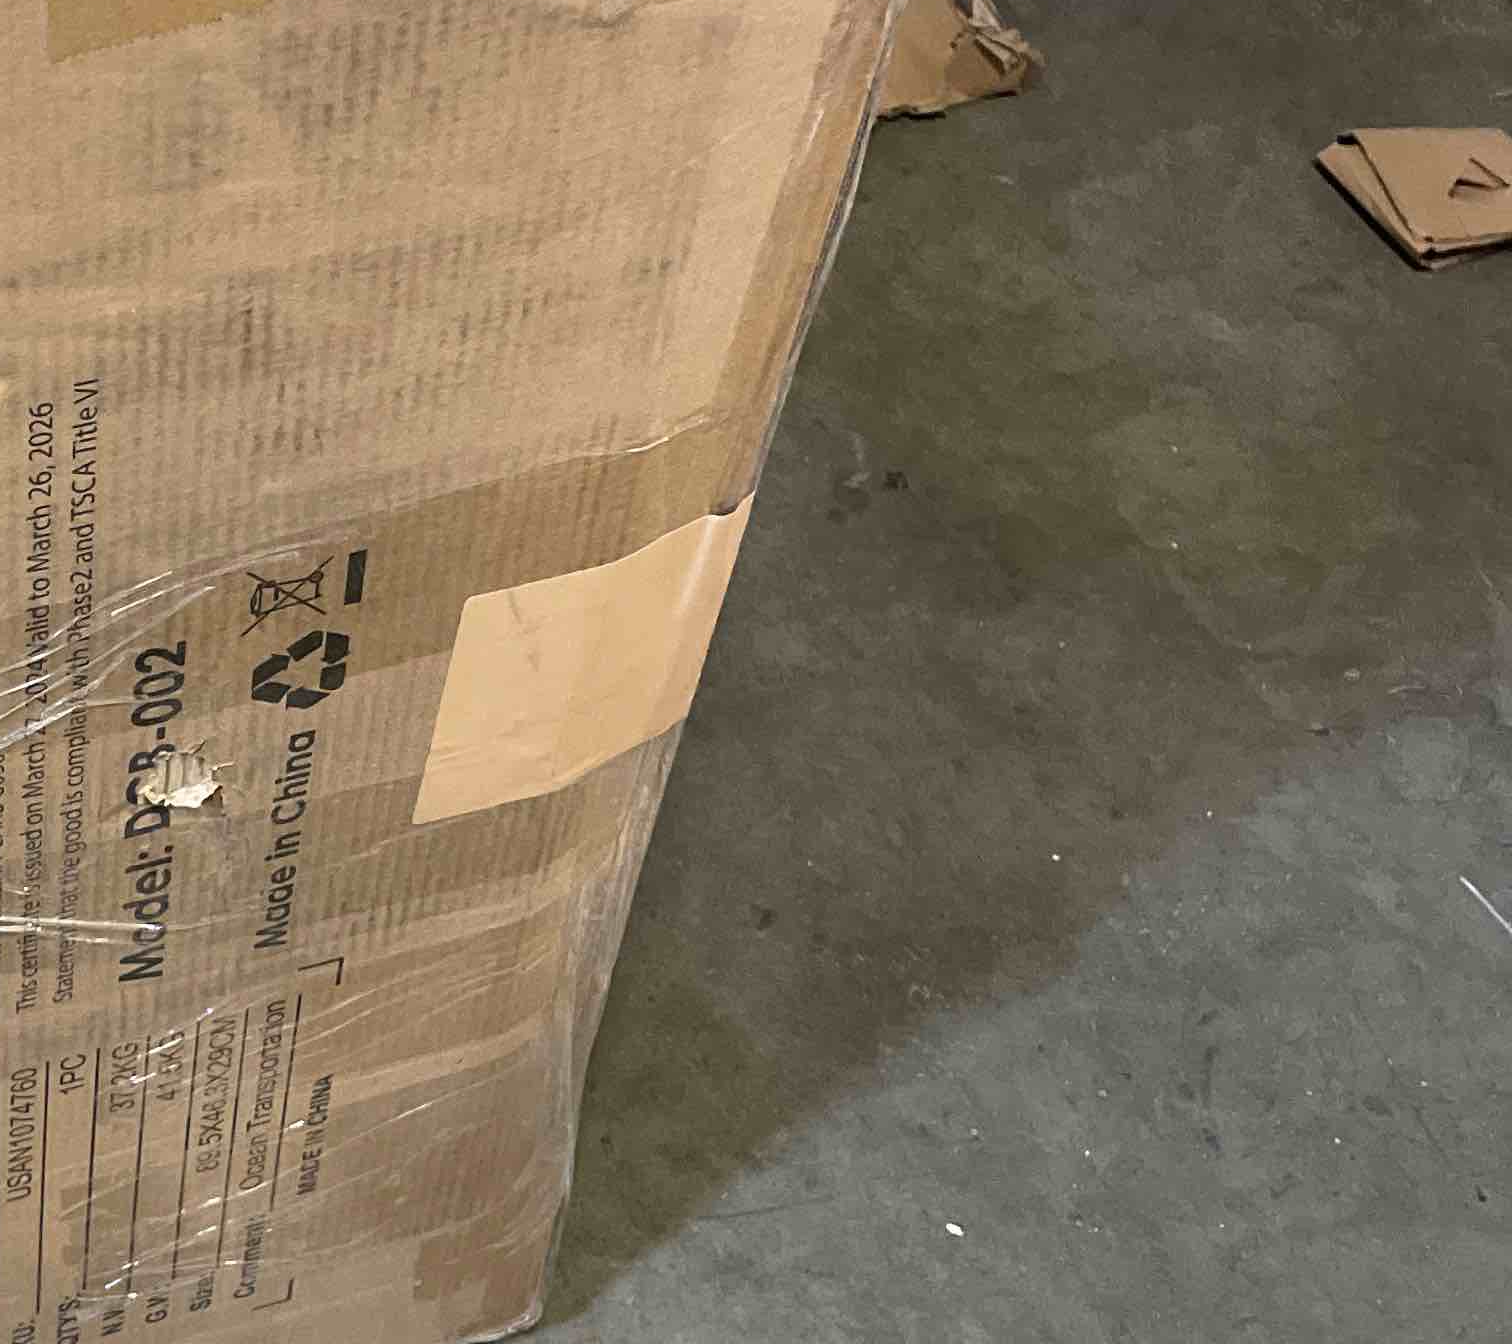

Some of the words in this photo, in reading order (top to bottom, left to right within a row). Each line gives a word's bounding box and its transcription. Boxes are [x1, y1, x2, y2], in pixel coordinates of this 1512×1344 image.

[73, 376, 101, 403] VI
[28, 401, 54, 459] 2026
[71, 406, 99, 456] Title
[27, 464, 56, 499] 26,
[69, 462, 98, 520] TSCA
[25, 504, 52, 571] March
[68, 523, 96, 561] and
[27, 577, 51, 600] to
[19, 742, 46, 799] March
[269, 727, 318, 824] China
[25, 802, 45, 824] on
[60, 808, 86, 853] good
[20, 828, 44, 880] issued
[57, 857, 80, 882] the
[264, 830, 302, 860] in
[116, 844, 175, 982] Model:
[252, 865, 299, 949] Made
[18, 900, 42, 976] certifite
[15, 978, 39, 1012] This
[58, 1051, 88, 1094] 1PC
[306, 1071, 334, 1125] CHINA
[5, 1065, 38, 1202] USAN1074760
[238, 1133, 268, 1189] Ocean
